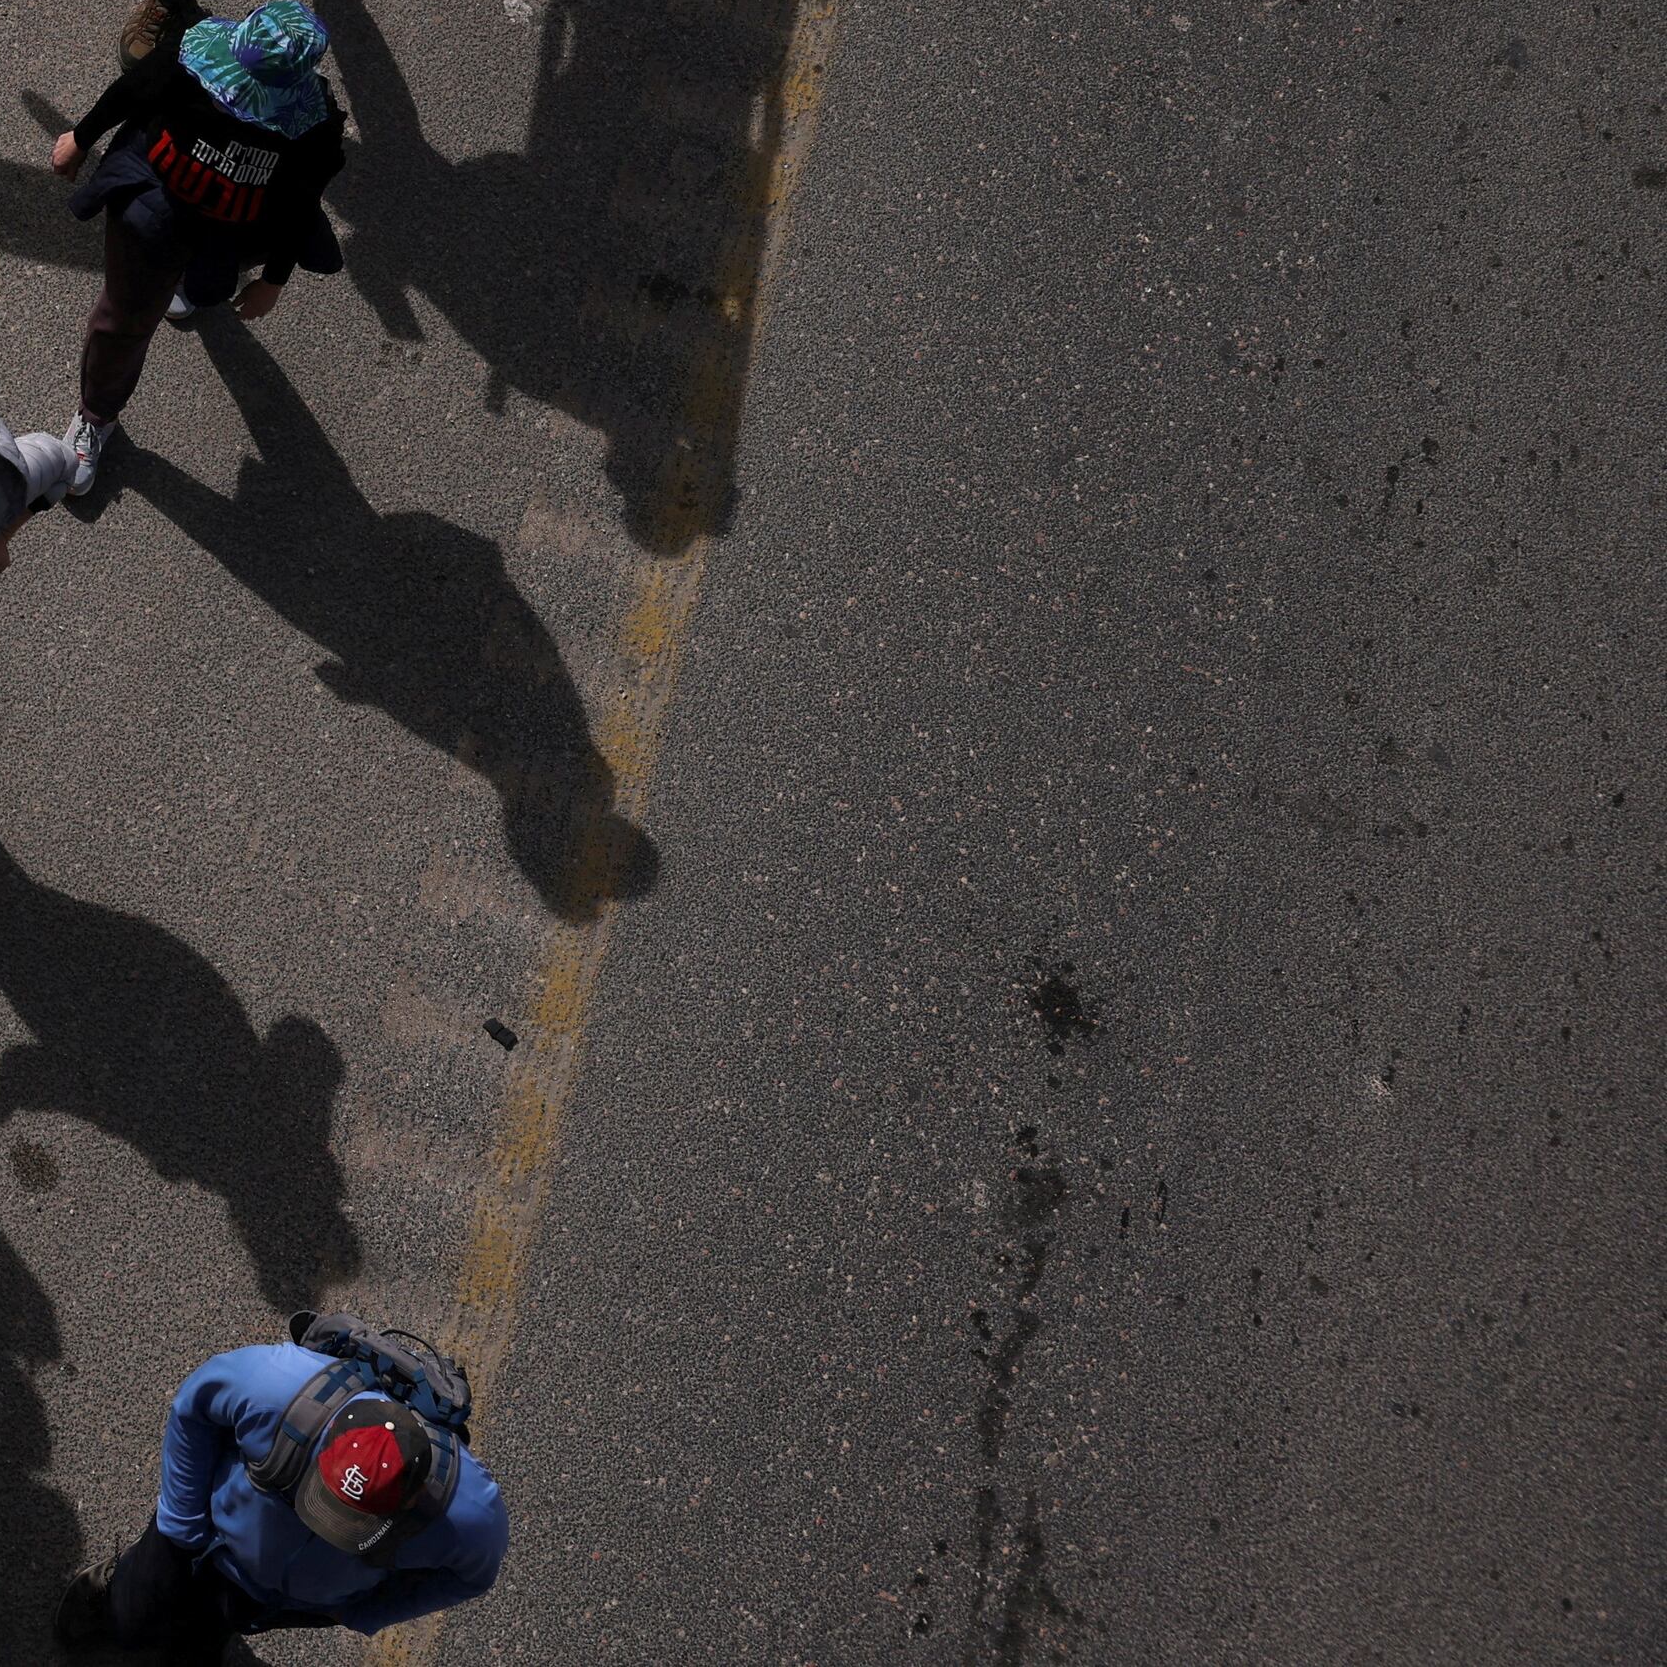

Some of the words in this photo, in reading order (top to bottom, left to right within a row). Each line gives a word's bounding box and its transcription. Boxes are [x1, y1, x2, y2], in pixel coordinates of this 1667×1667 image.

[191, 138, 236, 177] הביתה
[225, 140, 280, 168] מחזירים
[233, 164, 273, 186] אותם
